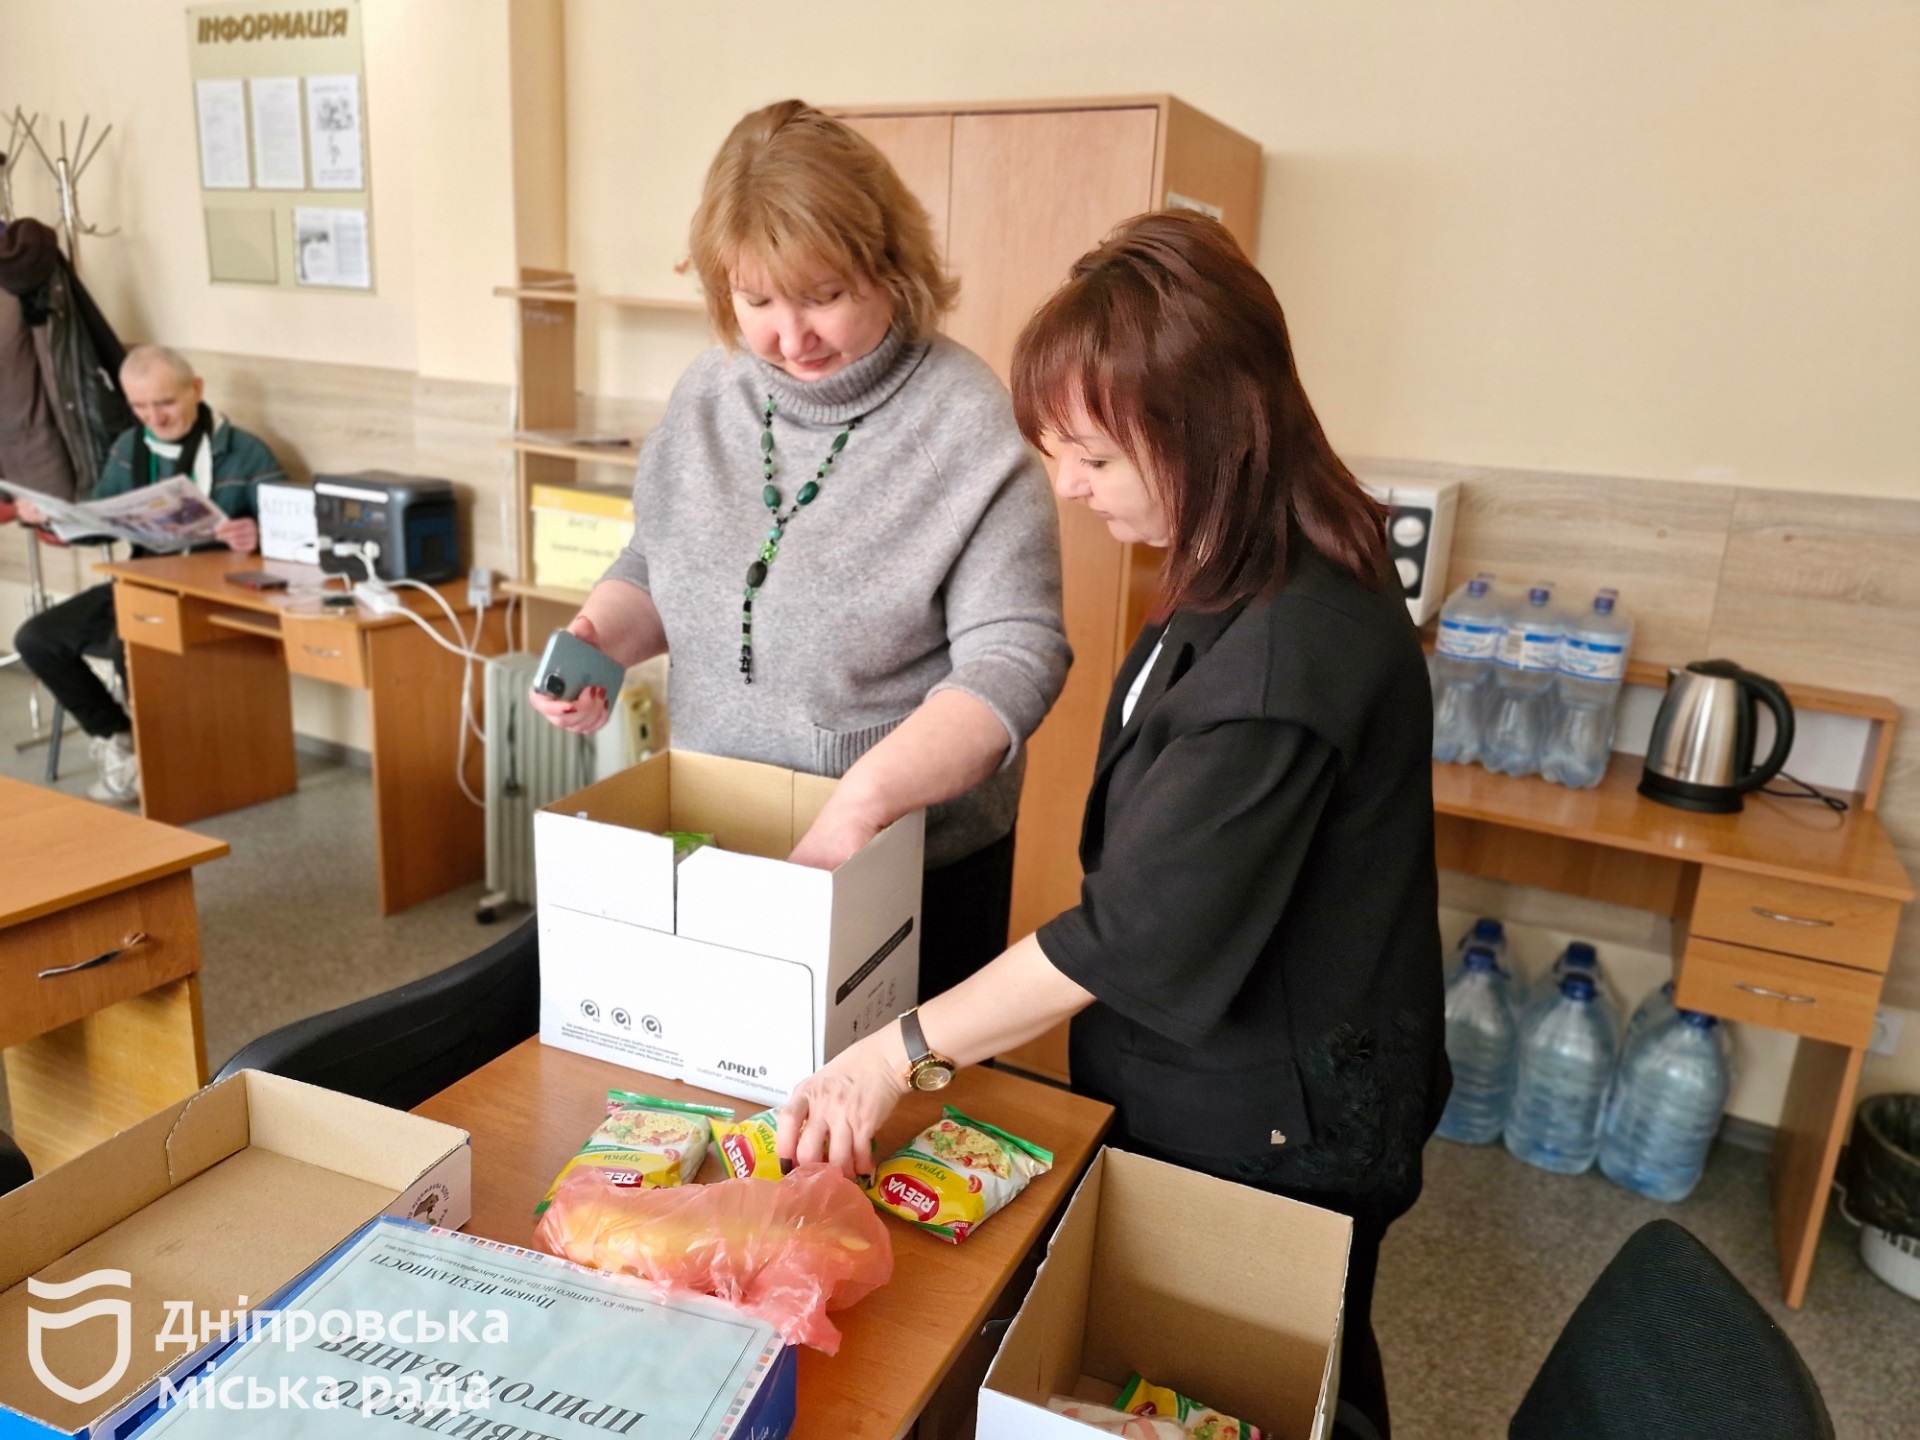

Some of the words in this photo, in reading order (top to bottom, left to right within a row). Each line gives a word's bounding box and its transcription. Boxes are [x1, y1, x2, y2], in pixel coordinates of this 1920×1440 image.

[197, 8, 348, 44] ІНФОРМАЦІЯ
[717, 1059, 759, 1079] APRIL
[724, 1135, 750, 1178] REEV
[888, 1176, 936, 1213] REEVA
[369, 1253, 499, 1296] НЕЗЛАМНОСТІ
[500, 1287, 557, 1310] Пункт
[313, 1330, 649, 1435] ПРИГОТУВАННЯ
